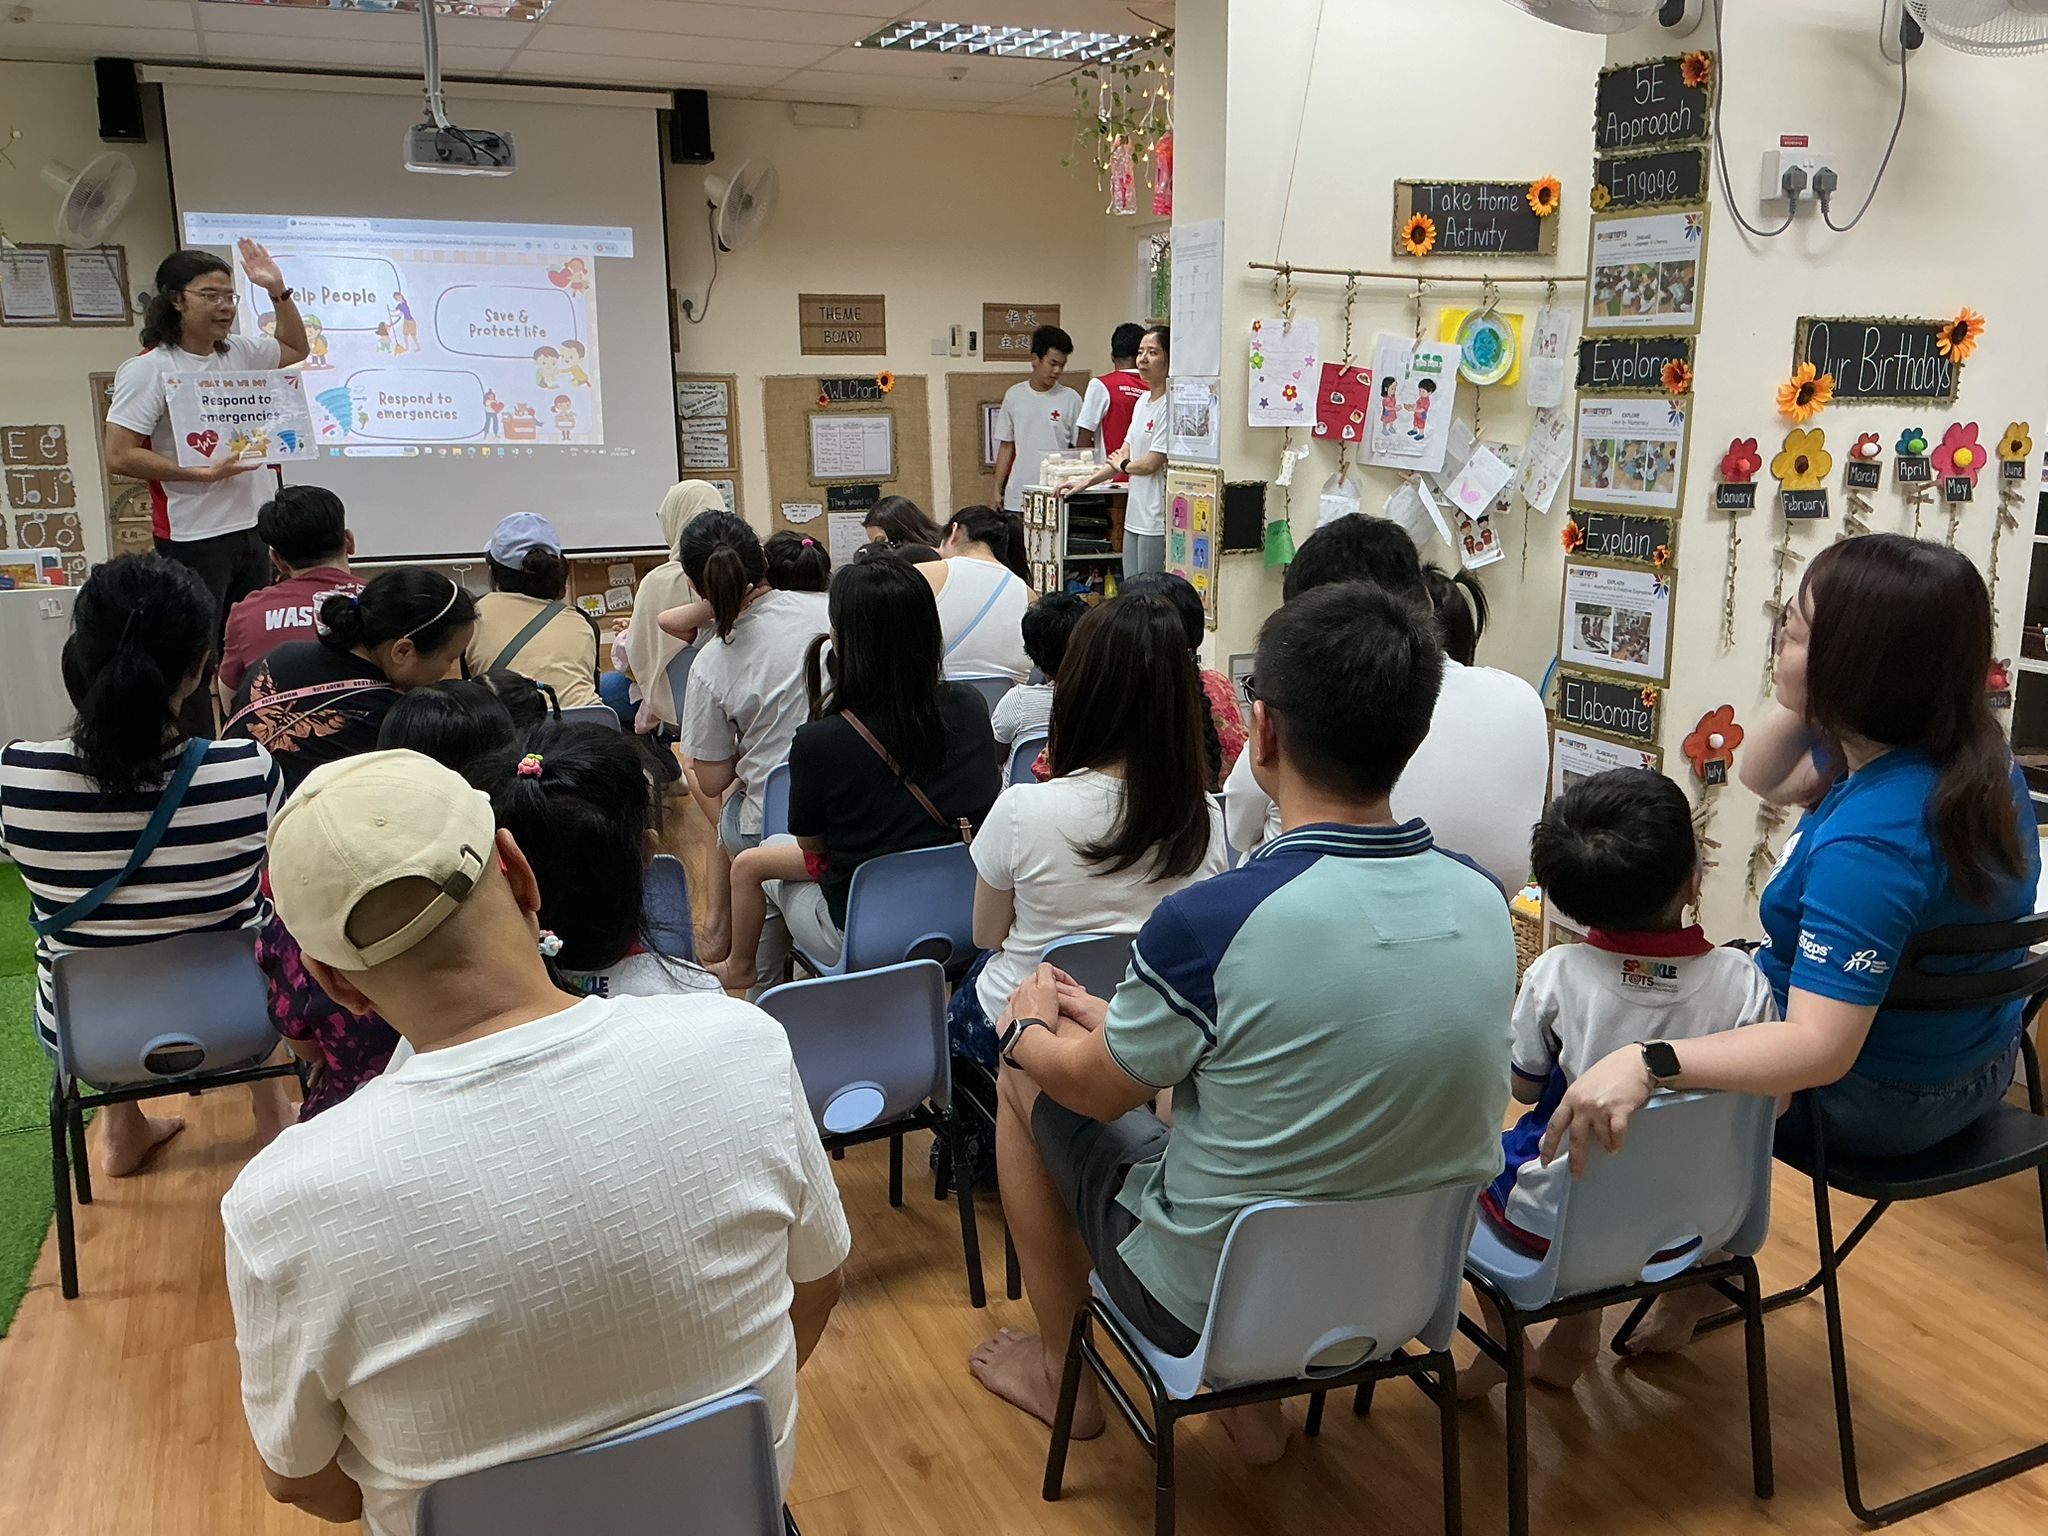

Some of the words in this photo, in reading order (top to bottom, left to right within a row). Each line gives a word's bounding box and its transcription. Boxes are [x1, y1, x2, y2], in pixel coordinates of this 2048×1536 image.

[1634, 64, 1665, 105] 5E
[1605, 100, 1691, 147] Approach
[1611, 160, 1679, 204] Engage
[1422, 186, 1472, 213] Take
[1478, 187, 1519, 212] Home
[1443, 217, 1507, 250] Activity
[293, 287, 316, 305] elp
[321, 286, 377, 307] People
[485, 308, 514, 322] Save
[518, 309, 528, 323] &
[818, 306, 862, 320] THEME
[469, 323, 520, 338] Protect
[524, 325, 547, 338] life
[823, 330, 862, 344] BOARD
[1593, 343, 1669, 384] Explore
[1808, 322, 1851, 391] Our
[1858, 327, 1951, 396] Birthdays
[238, 379, 249, 388] WE
[848, 380, 880, 399] Chart
[202, 394, 256, 407] Respond
[259, 395, 272, 405] to
[379, 391, 433, 408] Respond
[438, 392, 453, 404] to
[200, 410, 280, 424] emergencies
[376, 408, 458, 422] emergencies
[8, 431, 28, 460] E
[40, 434, 58, 459] e
[1850, 467, 1878, 483] March
[1900, 460, 1927, 479] April
[2004, 463, 2023, 478] June
[12, 474, 34, 505] J
[47, 476, 59, 505] j
[1717, 484, 1752, 508] January
[1947, 480, 1968, 499] May
[1783, 494, 1826, 517] February
[1586, 517, 1651, 556] Explain
[1566, 682, 1648, 733] Elaborate
[1622, 958, 1678, 979] SPARKLE
[1620, 971, 1655, 987] TOTS
